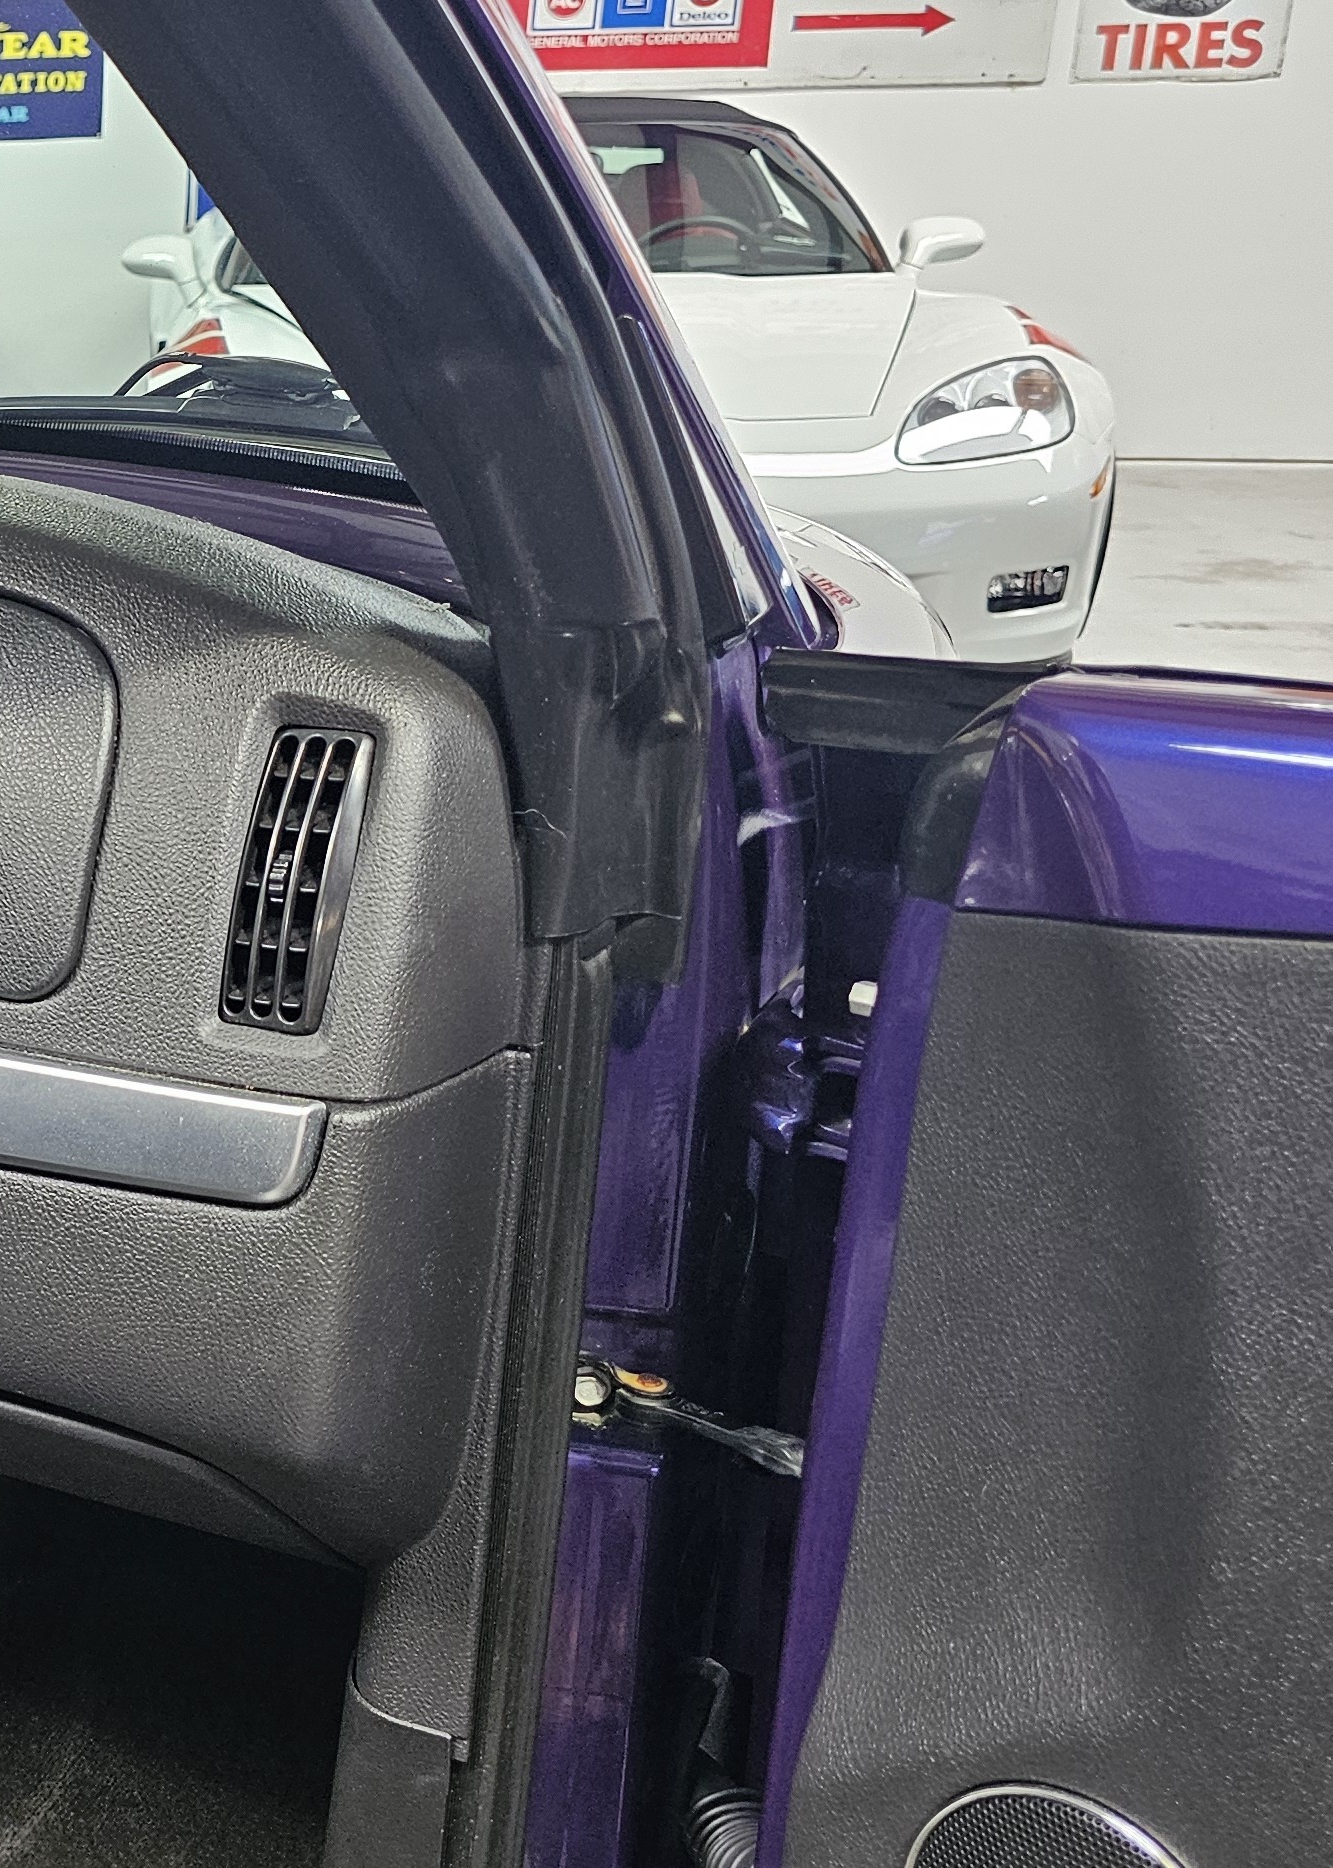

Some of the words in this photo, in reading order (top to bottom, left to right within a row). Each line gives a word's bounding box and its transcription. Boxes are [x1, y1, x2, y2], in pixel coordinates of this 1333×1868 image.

[678, 11, 730, 22] Delco
[587, 34, 644, 47] MOTORS
[646, 31, 739, 46] CORPORATION
[1096, 19, 1265, 71] TIRES
